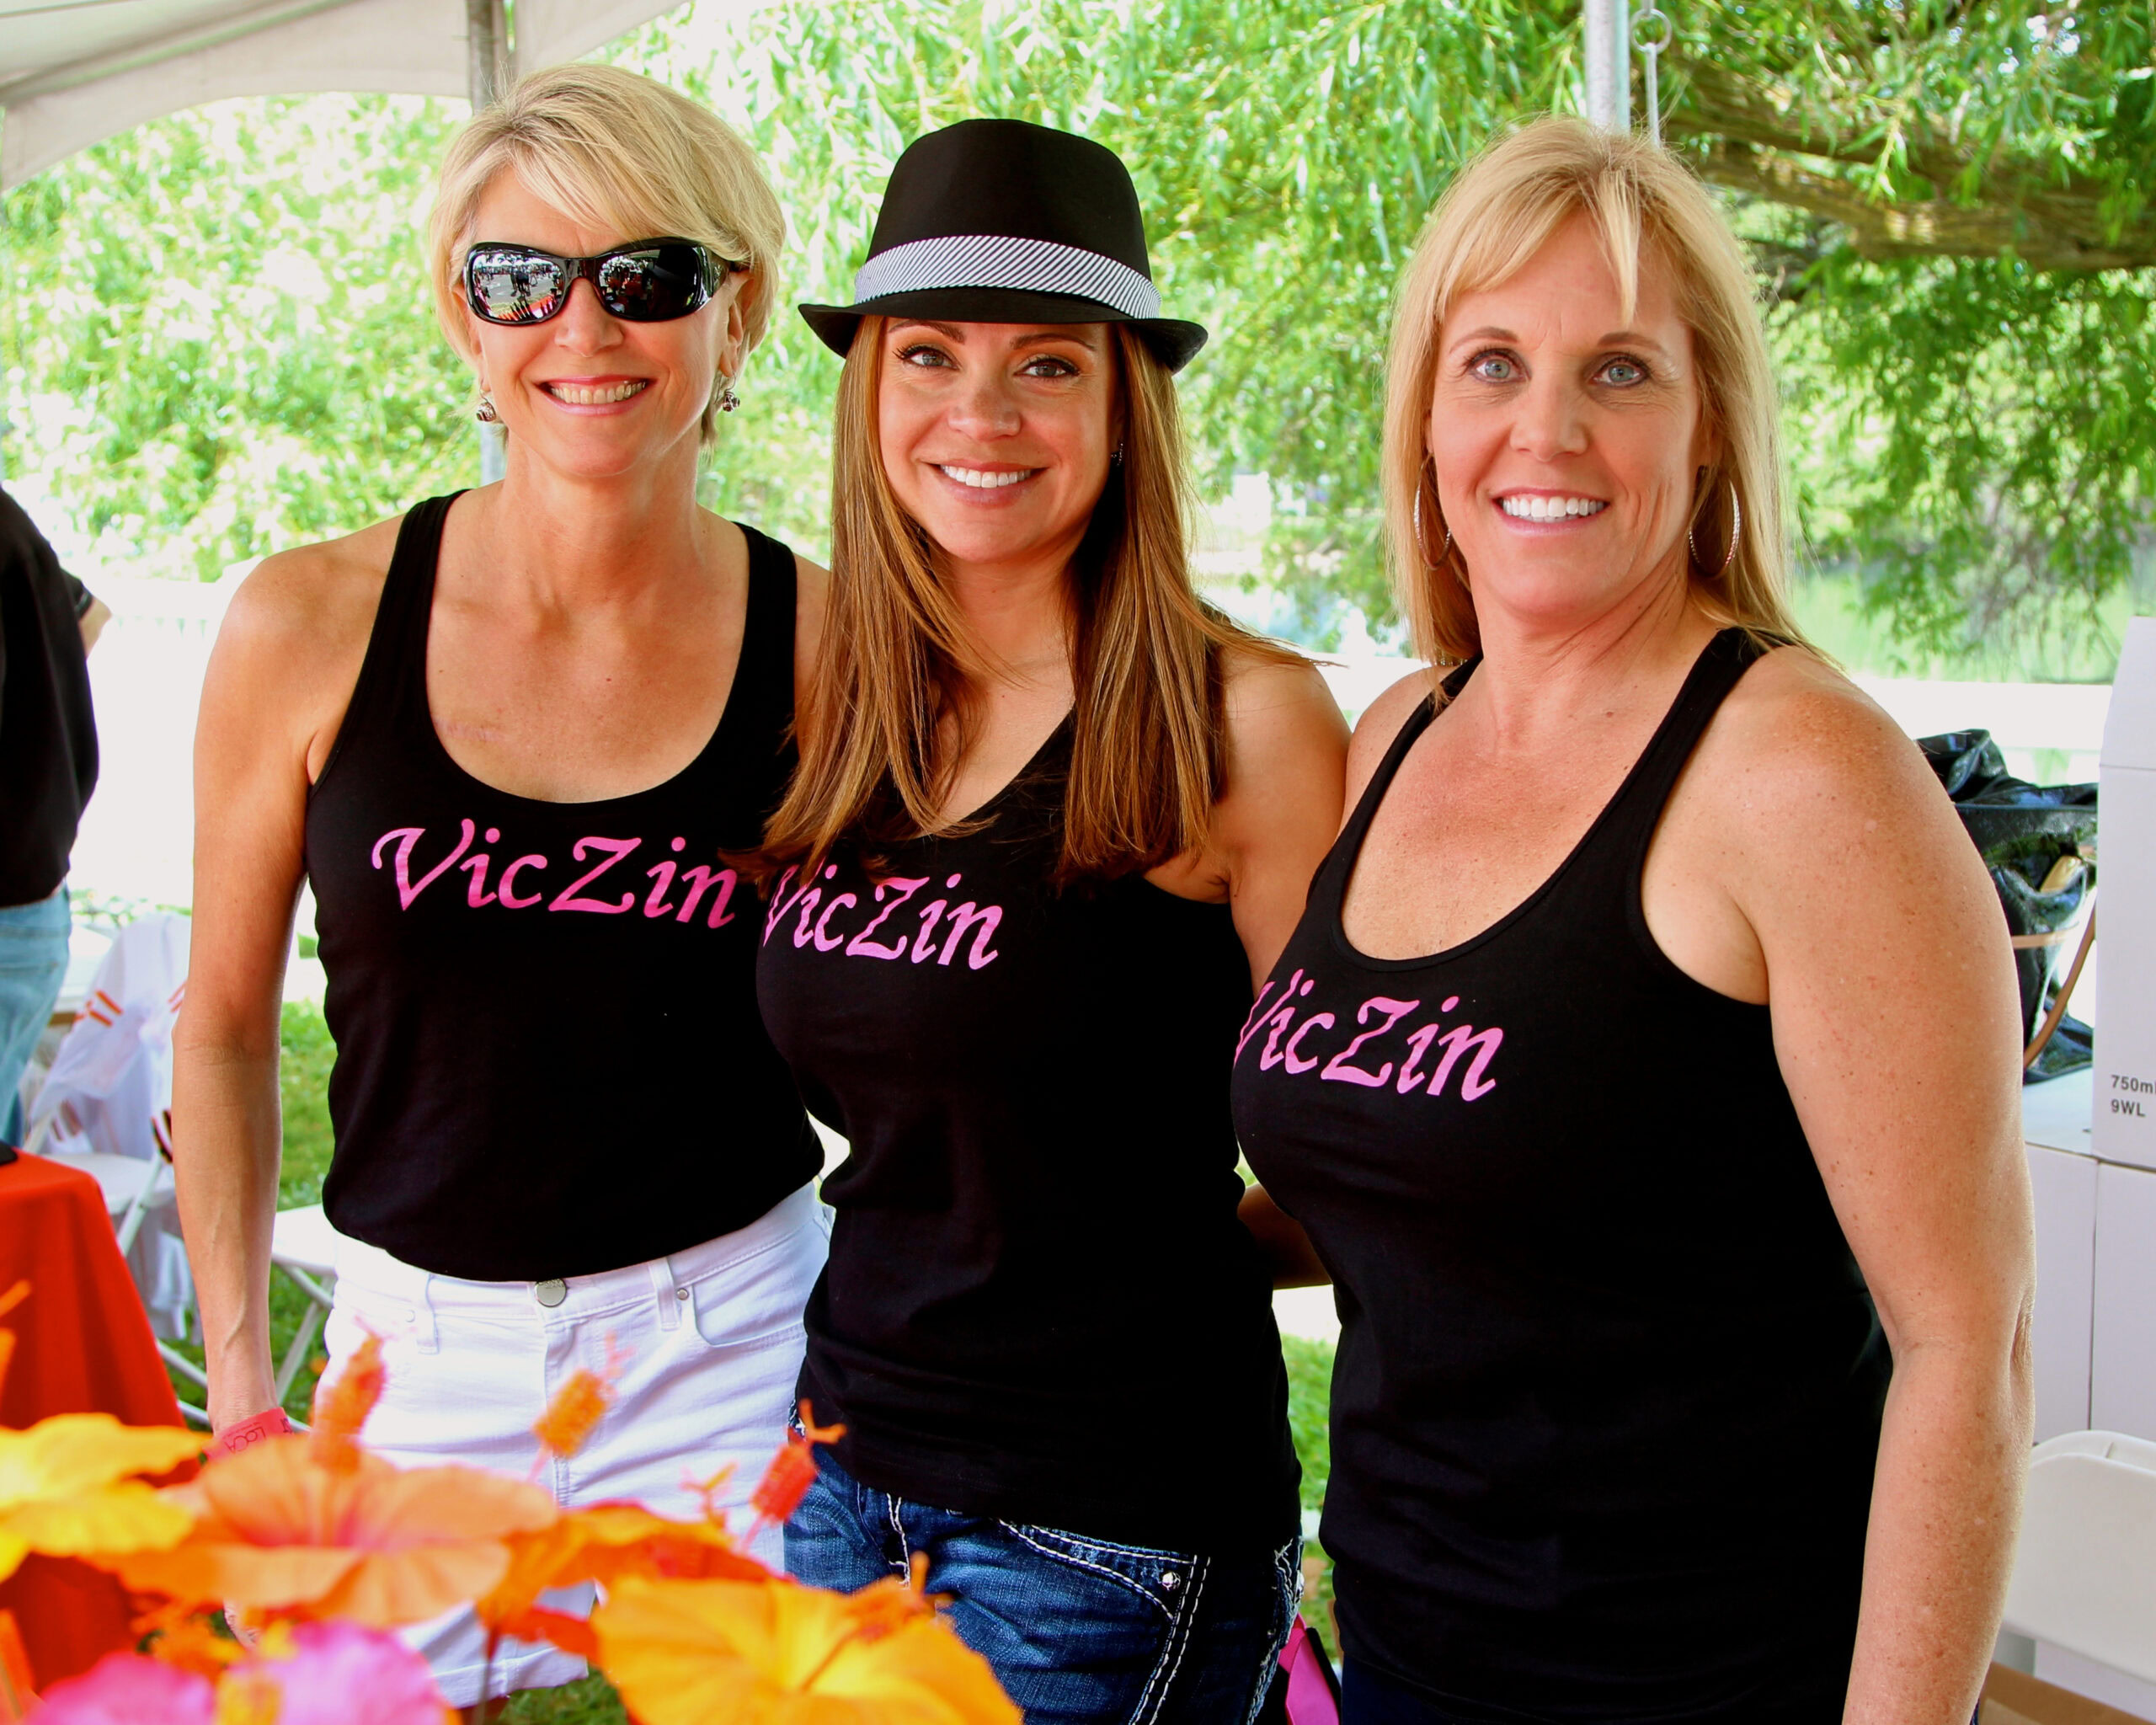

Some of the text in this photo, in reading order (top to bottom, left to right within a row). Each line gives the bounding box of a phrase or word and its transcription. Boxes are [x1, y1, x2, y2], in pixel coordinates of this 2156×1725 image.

[371, 818, 735, 928] VicZin
[763, 857, 1003, 970] VicZin
[2111, 1098, 2146, 1118] 9WL
